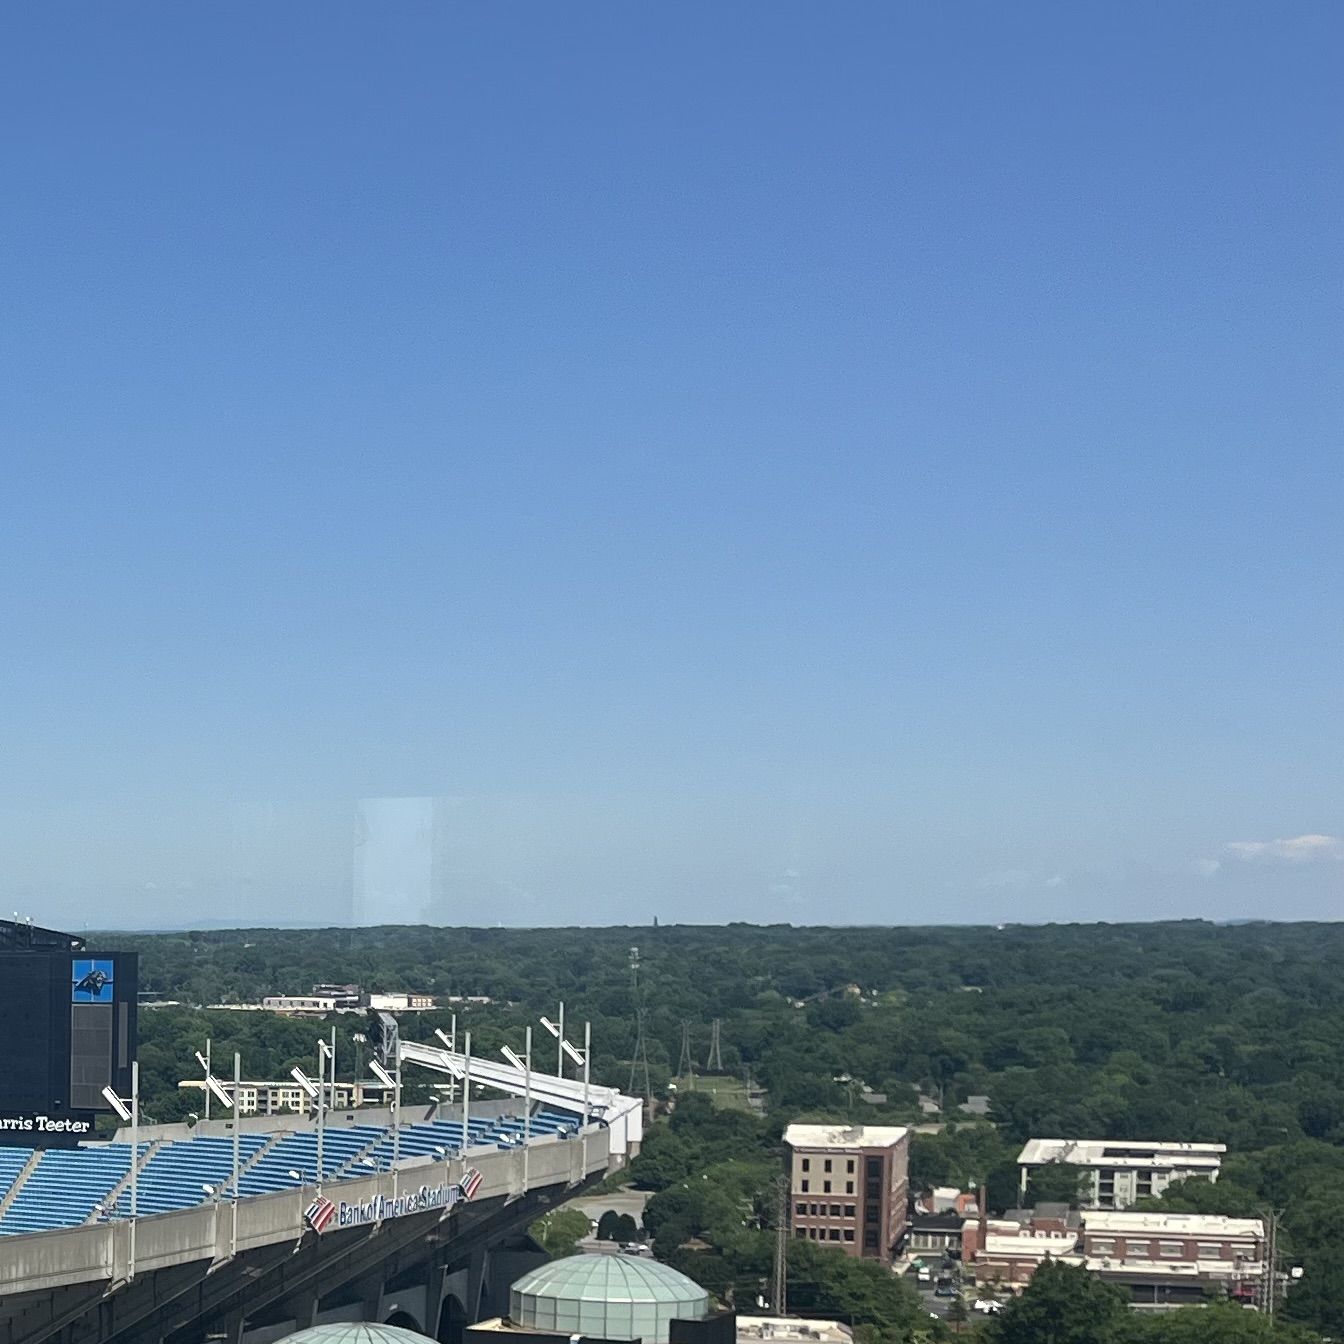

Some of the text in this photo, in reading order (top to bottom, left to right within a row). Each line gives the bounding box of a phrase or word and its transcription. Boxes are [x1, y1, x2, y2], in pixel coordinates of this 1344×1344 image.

[35, 1116, 90, 1133] Teeter
[339, 1184, 462, 1228] Bank of America Stadium
